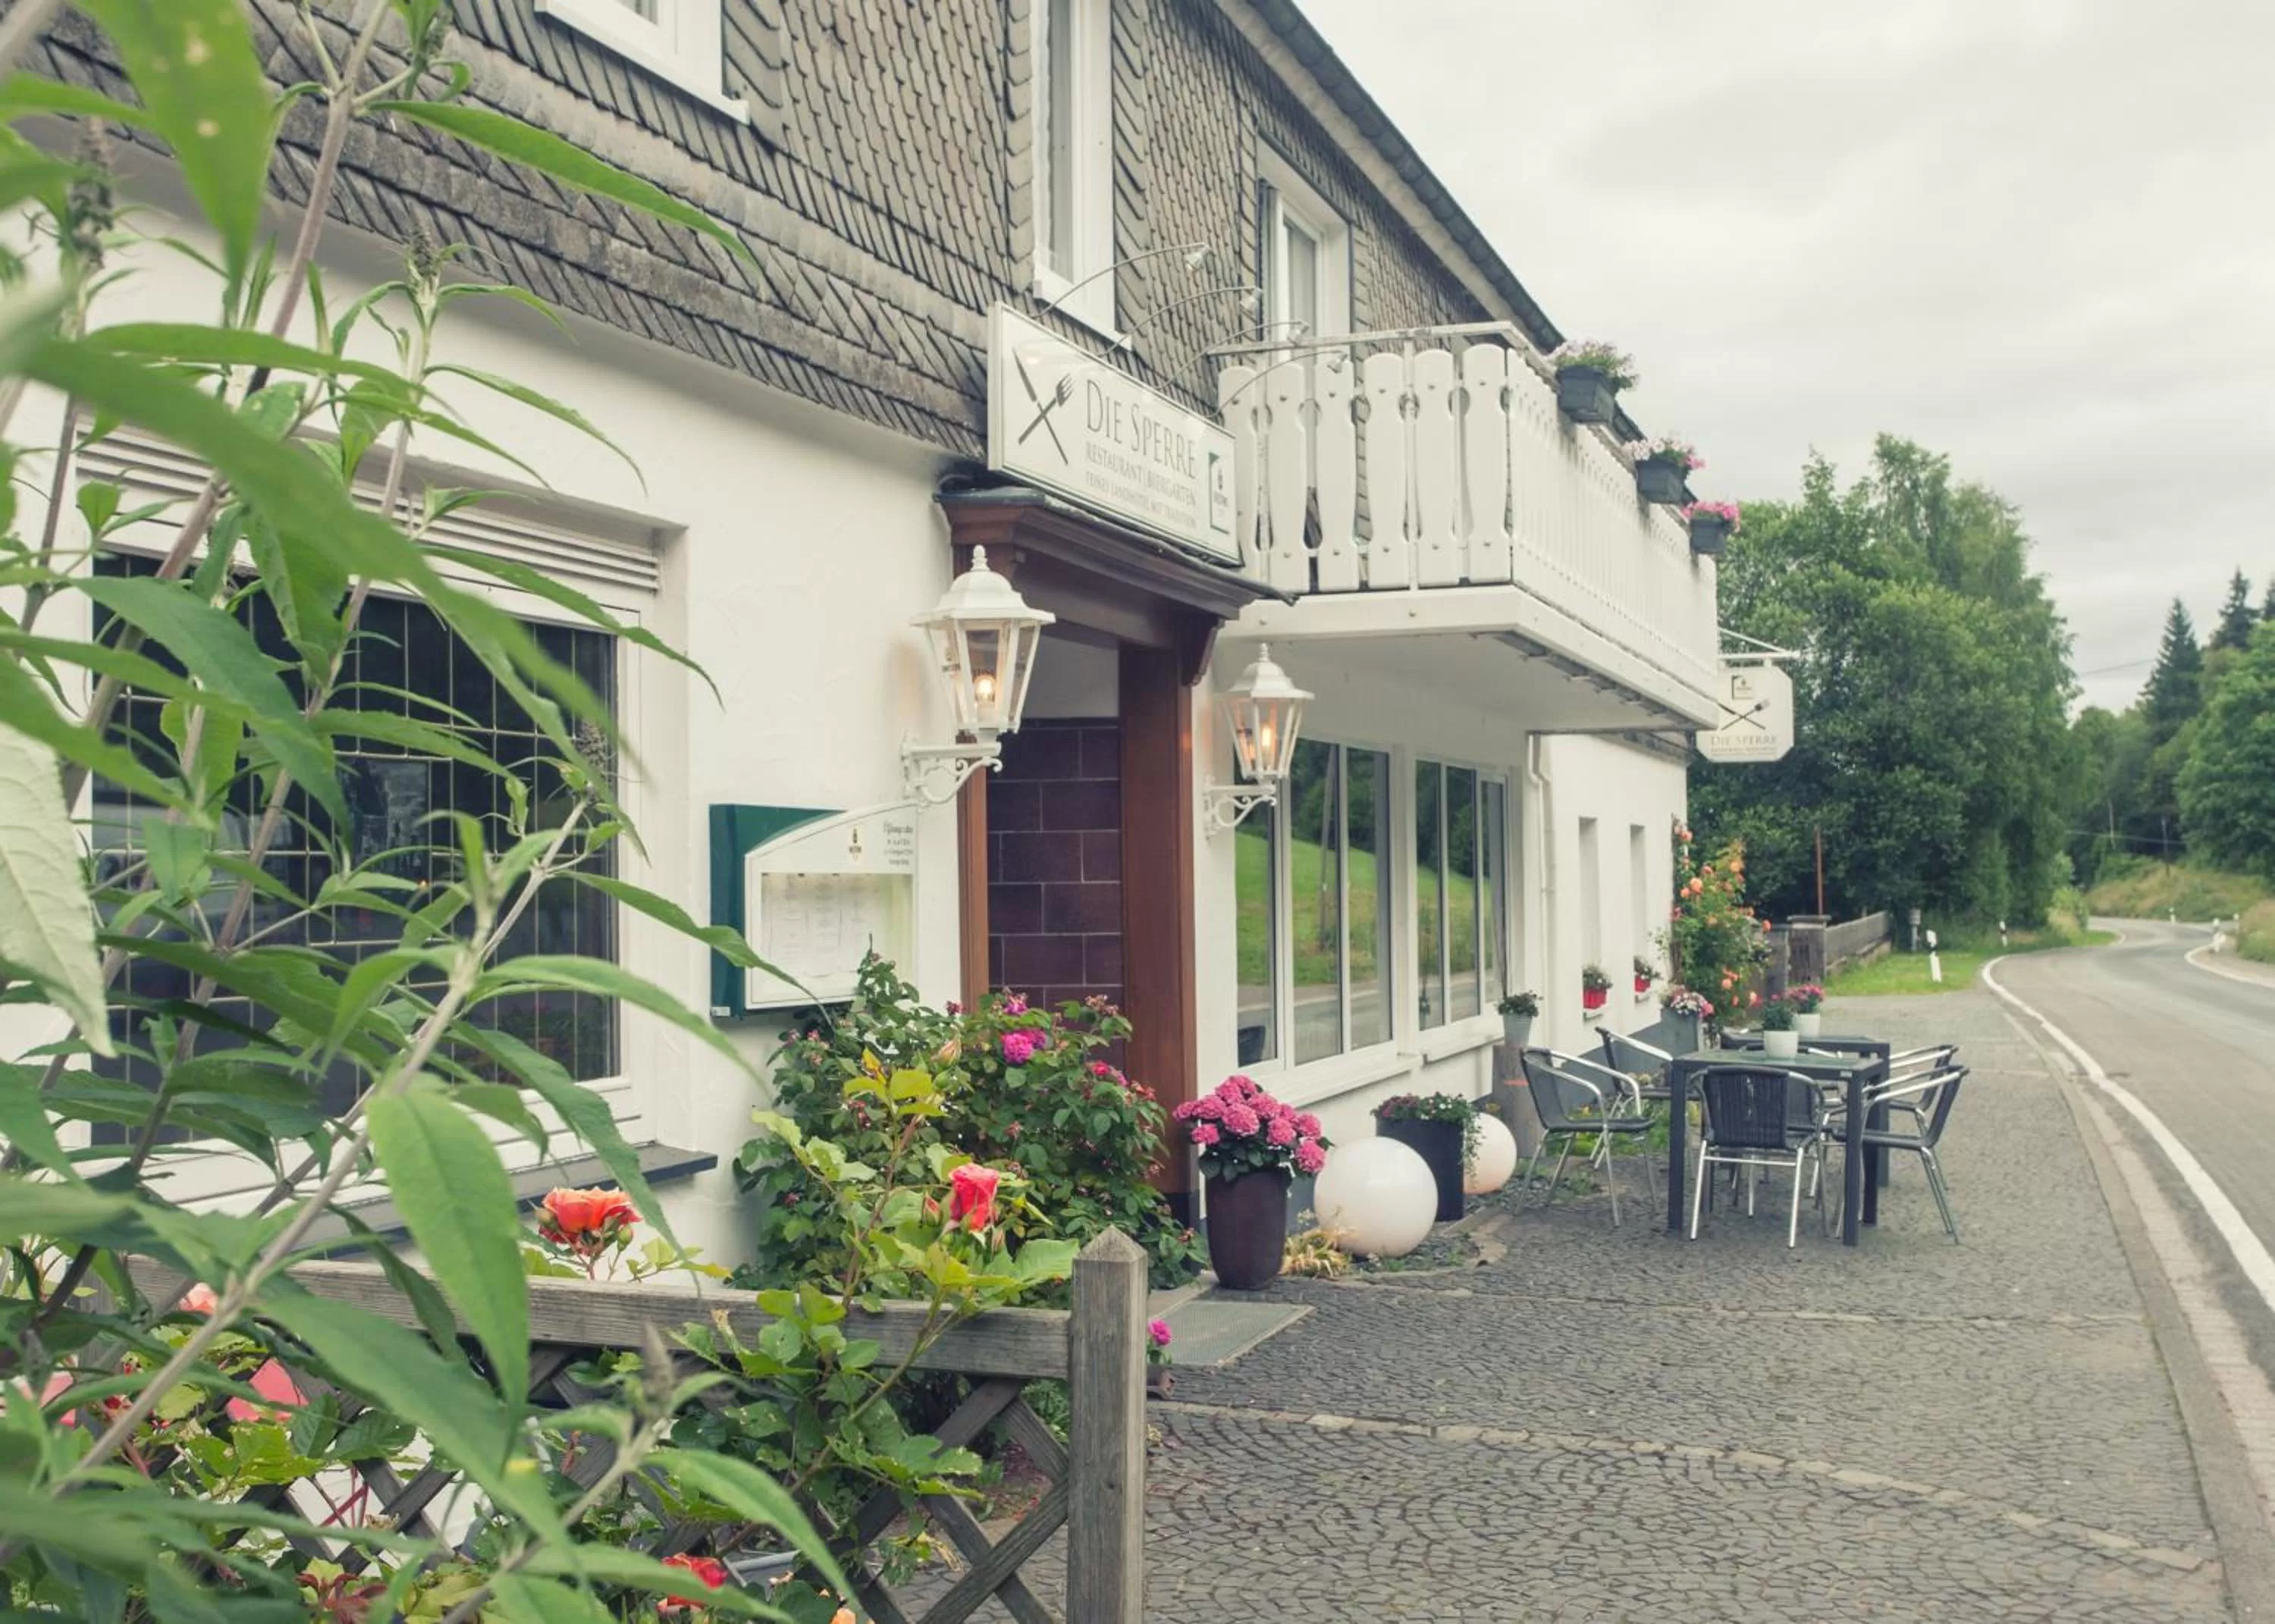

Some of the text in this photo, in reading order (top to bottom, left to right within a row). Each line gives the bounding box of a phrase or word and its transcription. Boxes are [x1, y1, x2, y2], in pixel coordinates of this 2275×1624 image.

[1085, 440, 1142, 484] RESTAURANT
[1087, 378, 1196, 479] DIE SPERRE
